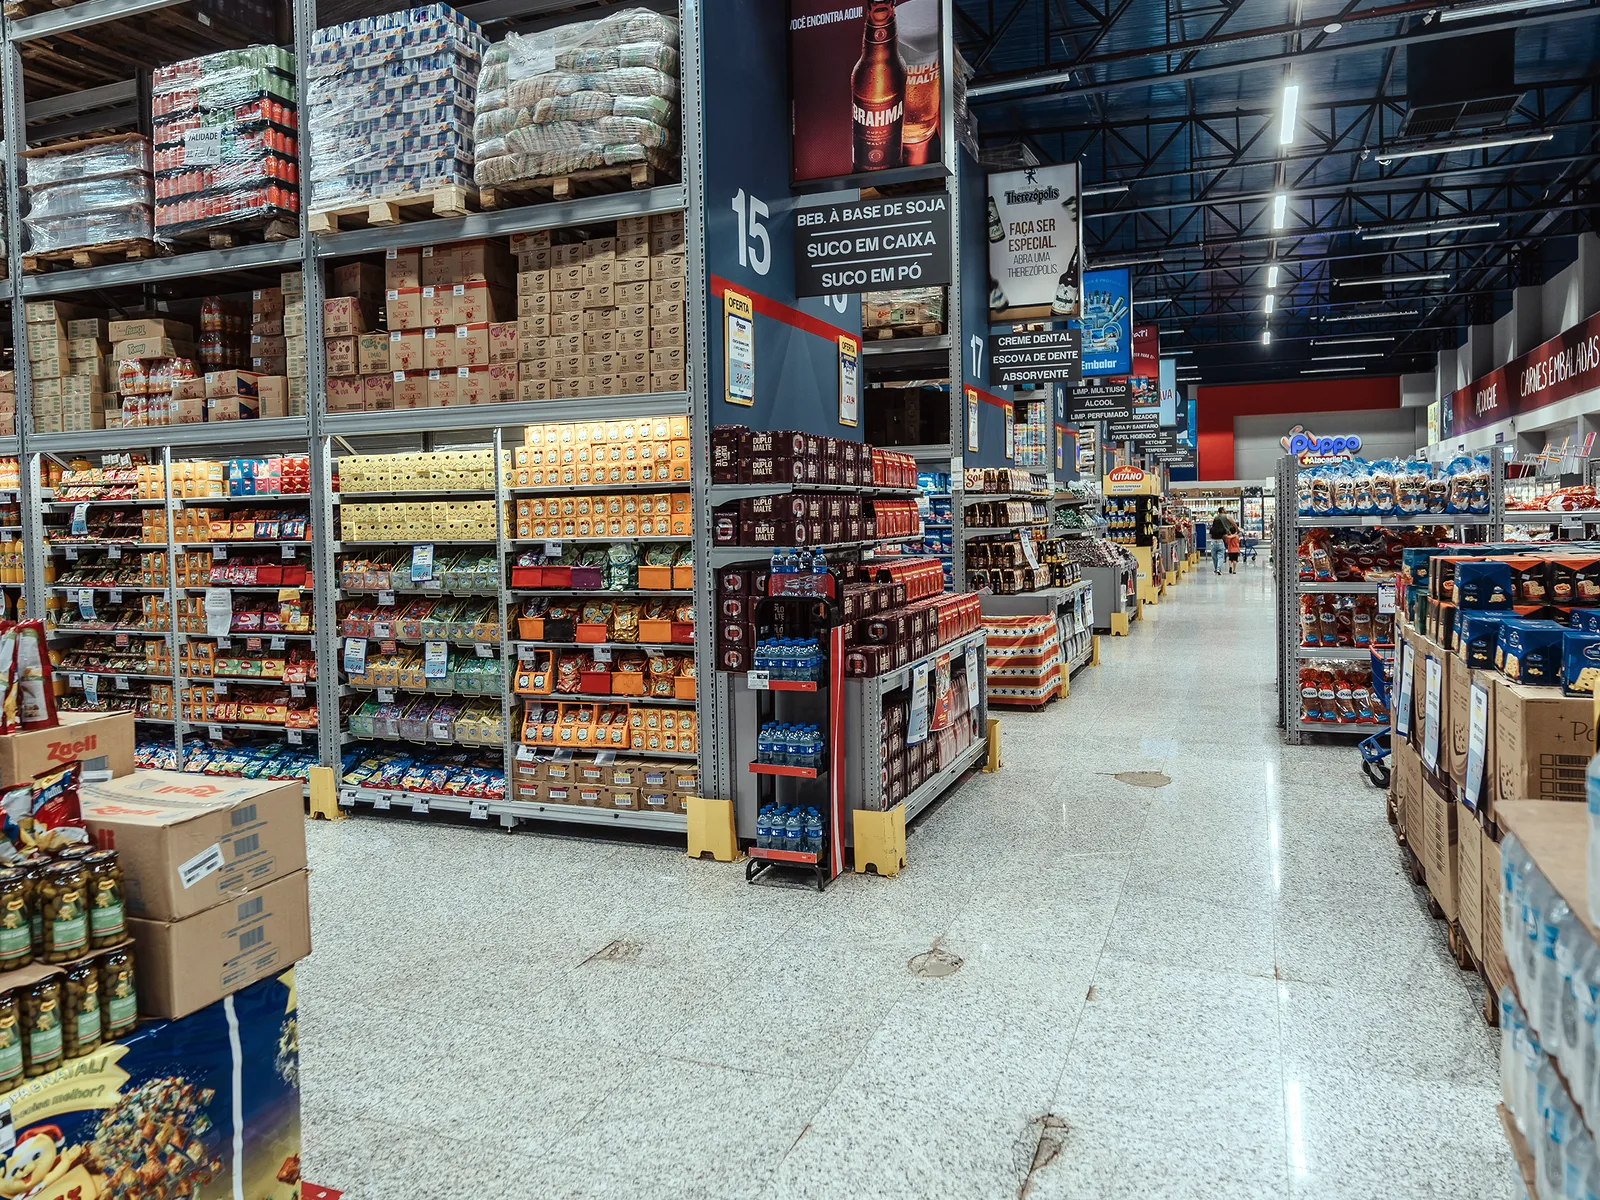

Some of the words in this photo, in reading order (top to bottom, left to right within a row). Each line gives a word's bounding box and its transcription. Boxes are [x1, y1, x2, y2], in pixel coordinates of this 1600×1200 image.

[807, 11, 842, 28] ENCONTRA
[844, 6, 862, 20] AQUI!
[906, 70, 940, 85] MALTE
[853, 100, 902, 128] BRAHMA
[1004, 186, 1060, 206] Therezópolis
[797, 212, 827, 227] BEB.
[830, 208, 840, 223] À
[842, 205, 881, 222] BASE
[884, 203, 902, 216] DE
[906, 198, 946, 214] SOJA
[732, 188, 770, 276] 15
[1009, 222, 1034, 236] FAÇA
[1036, 218, 1056, 232] SER
[807, 240, 852, 258] SUCO
[856, 236, 879, 252] EM
[882, 231, 936, 250] CAIXA
[1008, 236, 1056, 252] ESPECIAL.
[1013, 253, 1033, 264] ABRA
[1034, 252, 1050, 263] UMA
[822, 270, 868, 288] SUCO
[871, 267, 894, 282] EM
[898, 262, 922, 280] PÓ
[1008, 264, 1058, 278] THEREZÓPOLIS.
[728, 297, 750, 314] OFERTA
[842, 341, 856, 354] OFERTA
[998, 336, 1032, 346] CREME
[1033, 333, 1072, 344] DENTAL
[970, 334, 984, 378] 17
[993, 354, 1032, 364] ESCOVA
[1034, 352, 1046, 362] DE
[1048, 351, 1078, 360] DENTE
[1002, 369, 1069, 381] ABSORVENTE
[1520, 362, 1548, 397] CARNES
[1548, 335, 1600, 386] EMBALADAS
[1090, 386, 1126, 394] MULTIUSO
[1057, 388, 1064, 418] 19
[1084, 399, 1114, 407] ÁLCOOL
[1476, 383, 1498, 418] AÇOUGUE
[1291, 434, 1360, 455] Puppo
[966, 474, 984, 488] SOL
[1112, 472, 1142, 480] KITANO
[47, 734, 97, 762] Zaeli
[154, 784, 224, 798] Zaeli
[89, 806, 164, 816] Zaeli
[98, 829, 115, 850] li
[40, 1056, 108, 1088] NATAL!
[52, 1084, 105, 1105] melhor?
